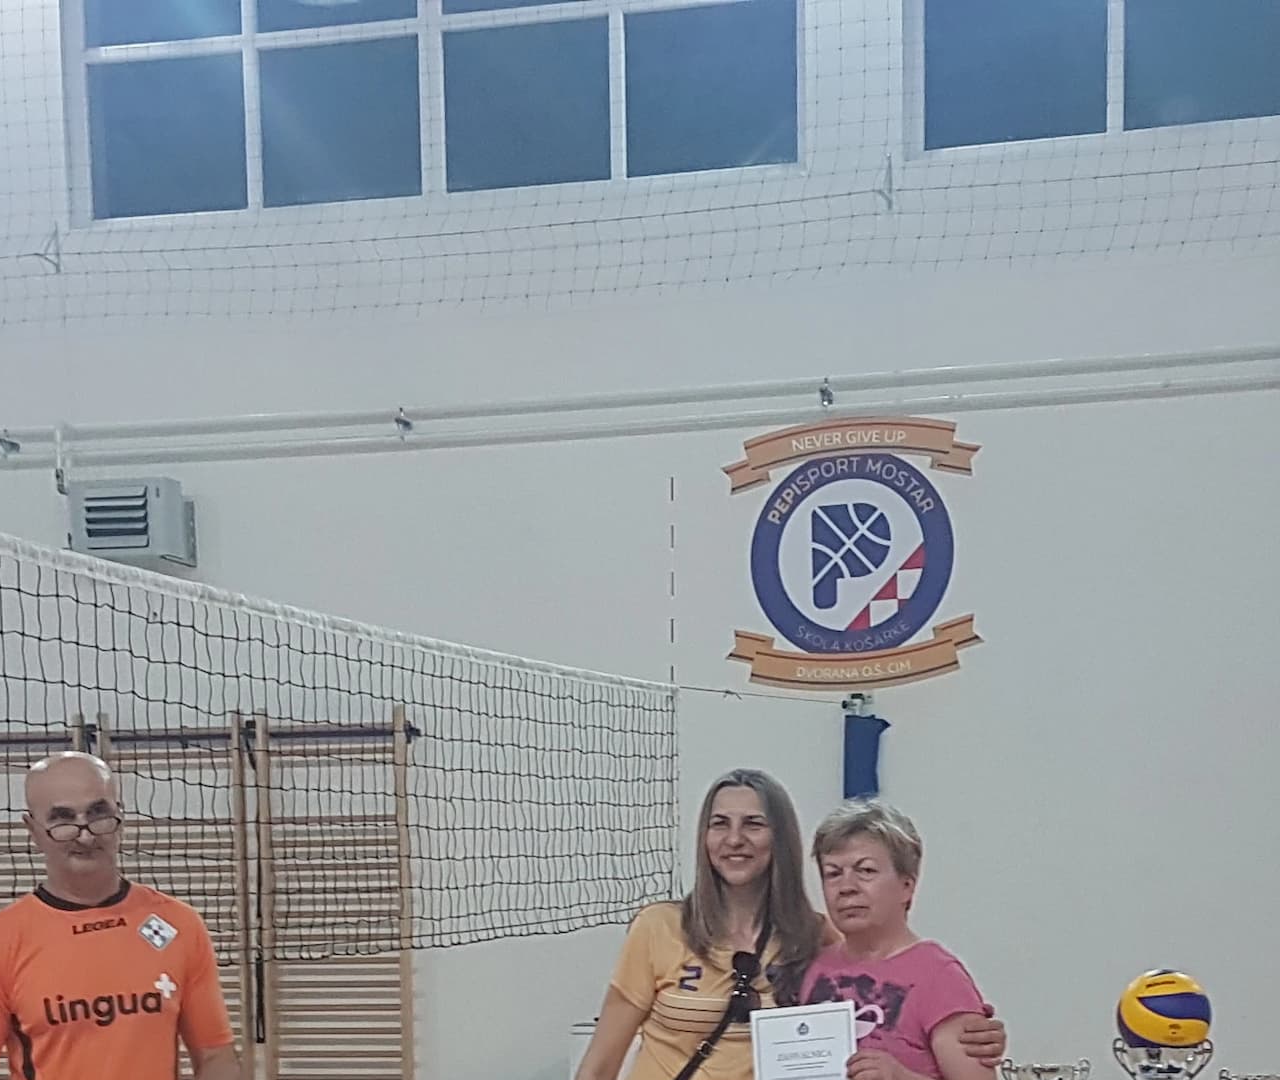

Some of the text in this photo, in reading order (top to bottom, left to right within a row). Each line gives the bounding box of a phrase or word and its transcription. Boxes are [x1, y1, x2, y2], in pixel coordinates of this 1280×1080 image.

[791, 430, 907, 451] NEVER GIVE UP
[767, 457, 935, 525] PEPISPORT MOSTAR
[795, 666, 859, 679] DVORANA
[887, 660, 912, 674] CIM
[72, 918, 127, 934] LEGEA
